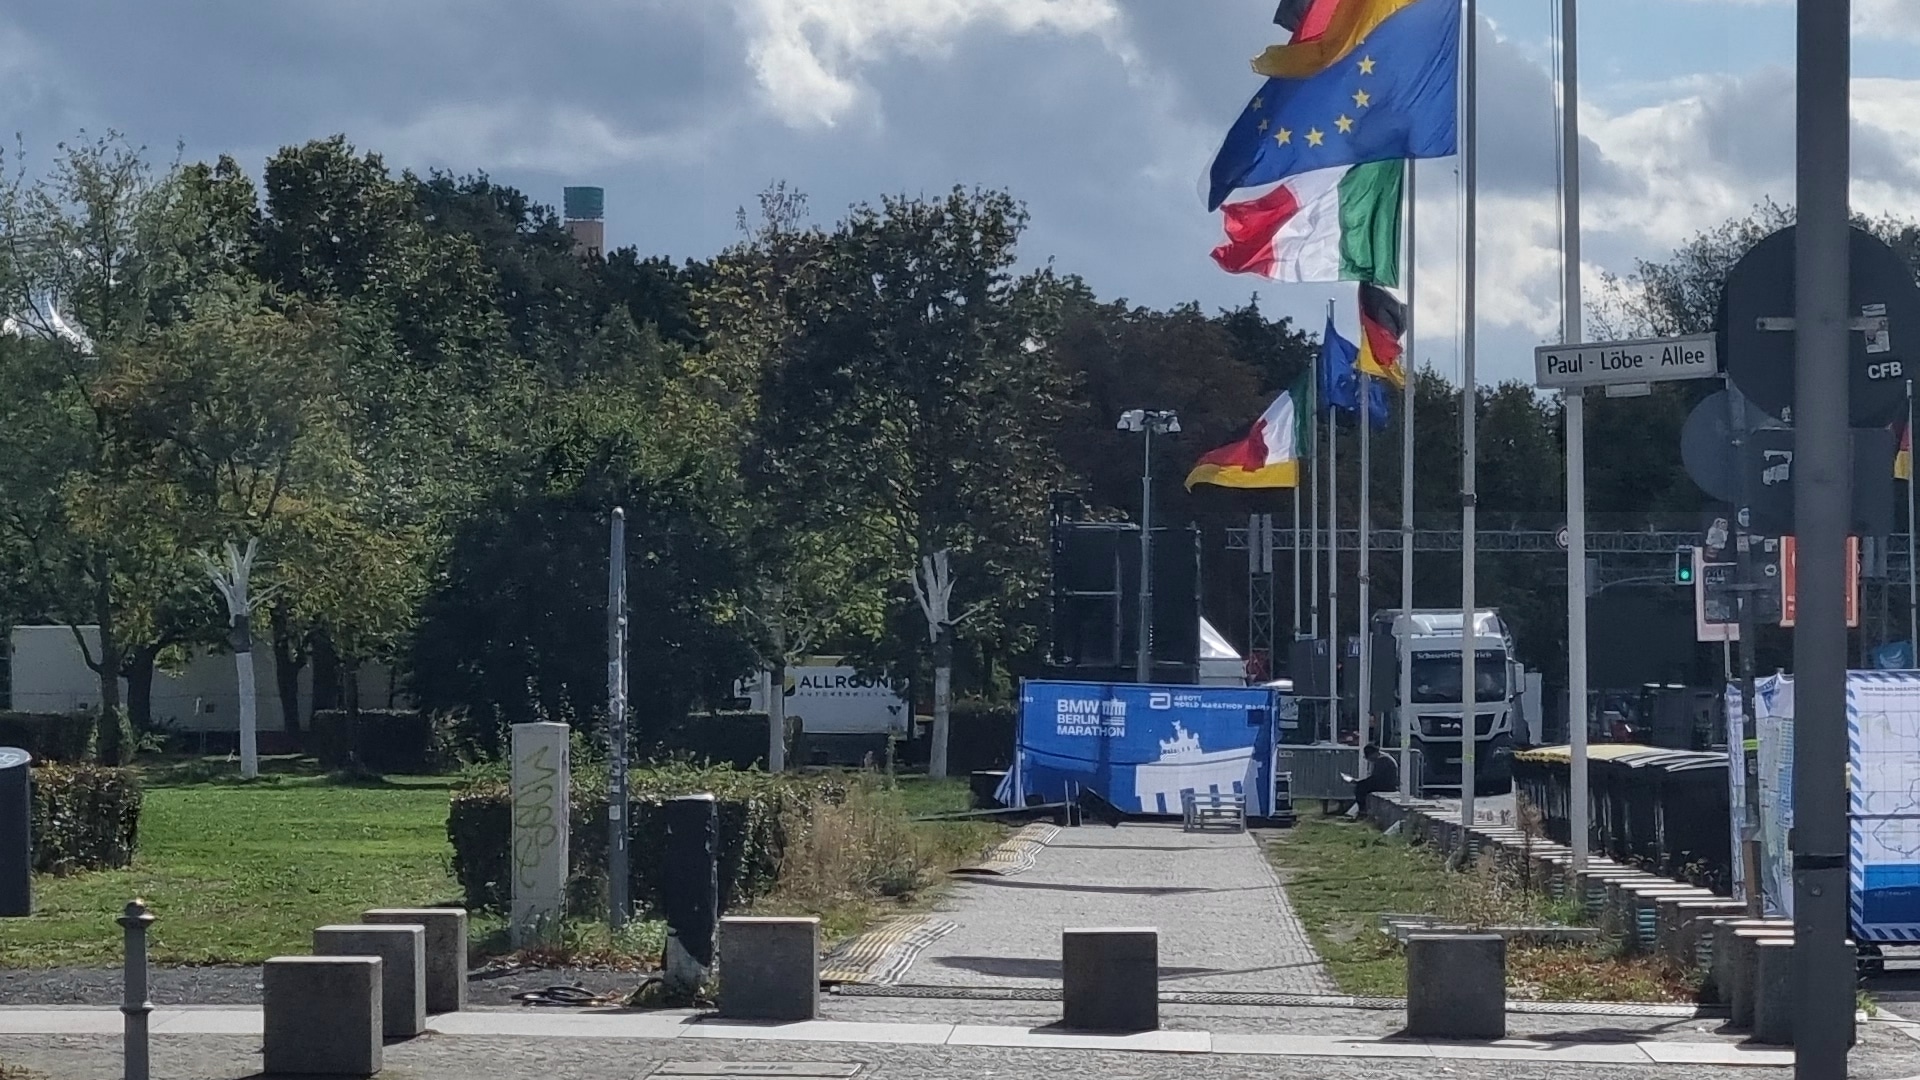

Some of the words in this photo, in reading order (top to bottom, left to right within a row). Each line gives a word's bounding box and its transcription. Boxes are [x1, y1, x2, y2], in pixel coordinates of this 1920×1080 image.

[1547, 353, 1583, 375] Paul
[1600, 350, 1643, 370] Löbe
[1660, 346, 1705, 366] Allee
[1867, 361, 1903, 379] CFB
[1057, 699, 1100, 714] BMW
[1201, 702, 1243, 710] MARATHON
[1056, 713, 1100, 725] BERLIN
[1056, 725, 1126, 738] MARATHON
